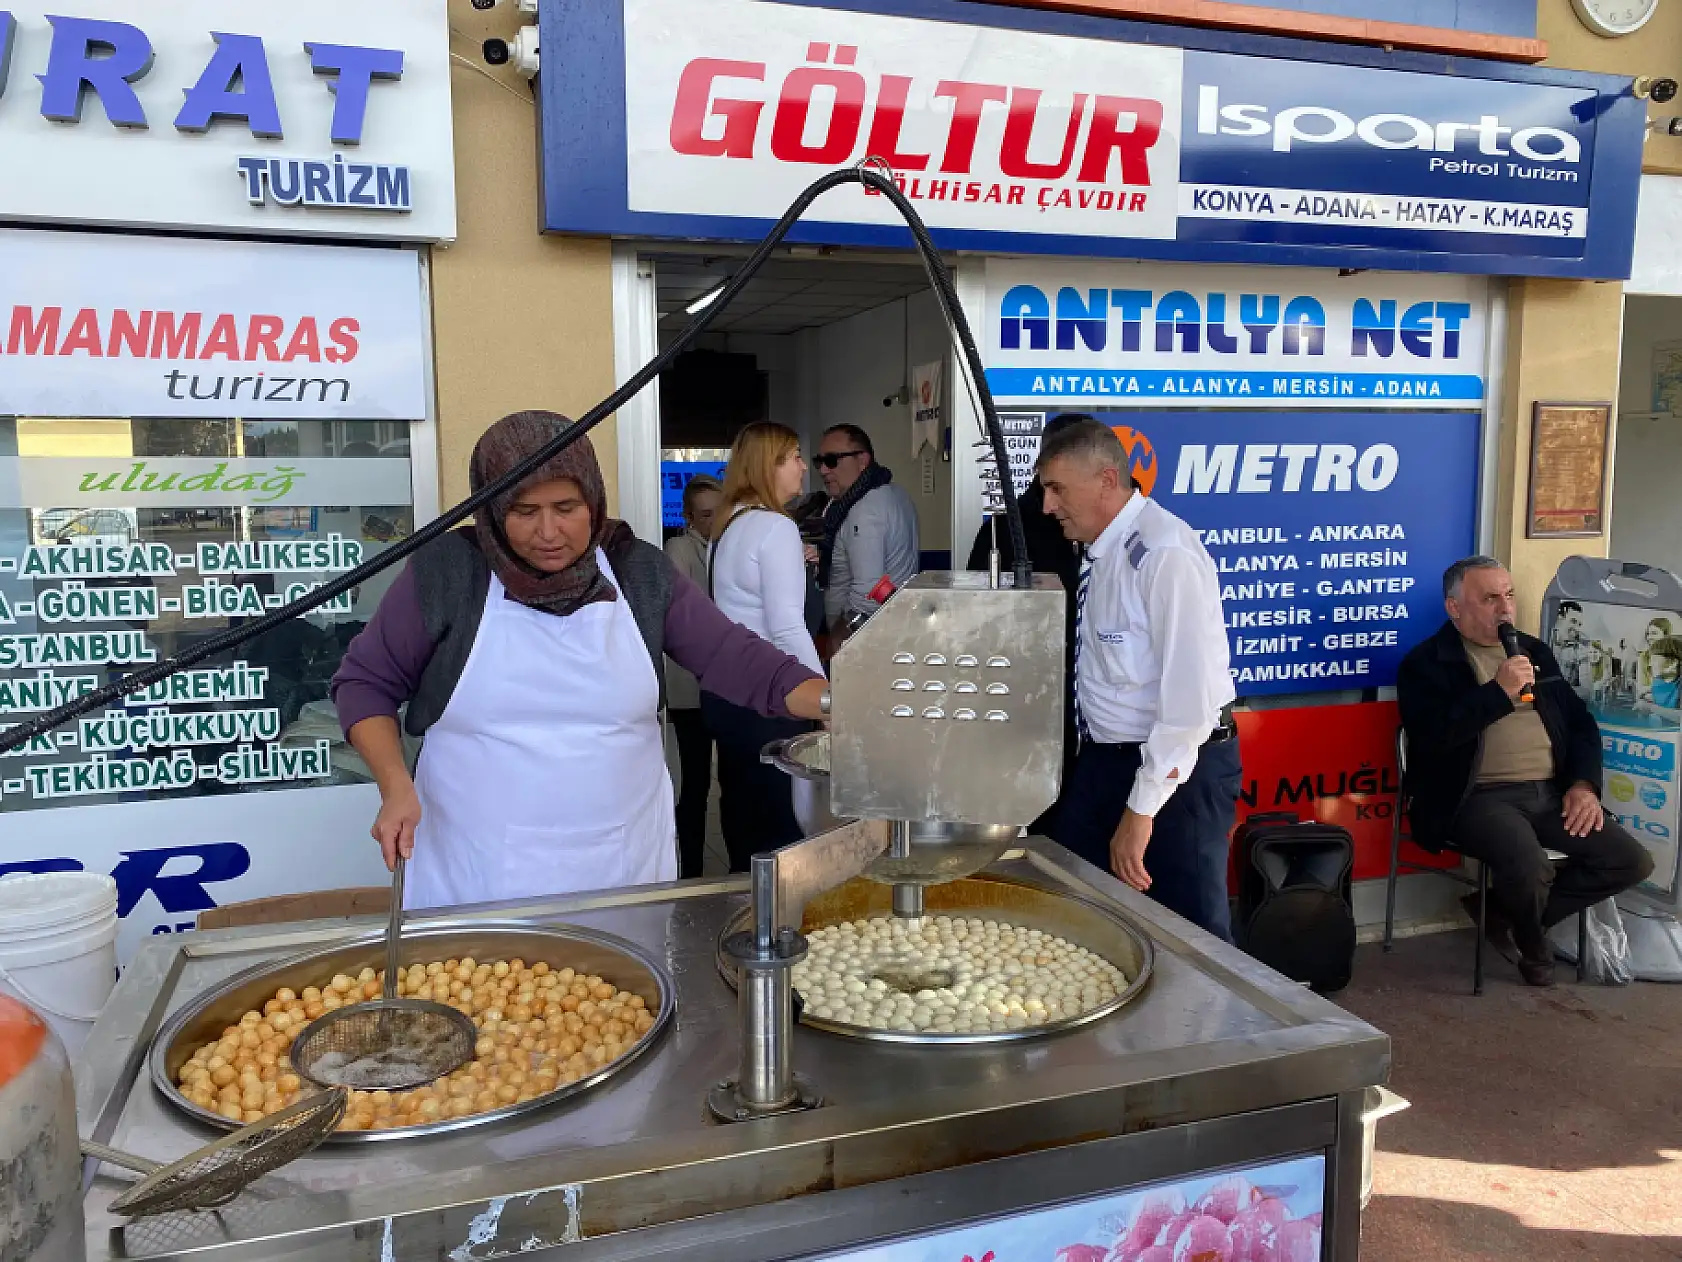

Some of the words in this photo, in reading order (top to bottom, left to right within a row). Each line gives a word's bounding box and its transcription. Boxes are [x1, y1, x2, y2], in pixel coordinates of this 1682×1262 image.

[0, 11, 406, 145] RAT
[669, 41, 1163, 187] GÖLTUR
[1198, 85, 1580, 163] Isparta
[238, 153, 411, 210] TURİZM
[1429, 157, 1498, 176] Petrol
[1037, 187, 1147, 213] ÇAVDIR
[1193, 189, 1274, 213] KONYA
[1294, 195, 1376, 220] ADANA
[1397, 202, 1465, 225] HATAY
[1483, 207, 1573, 236] K.MARAŞ
[0, 304, 361, 365] MANMARAŞ
[1001, 284, 1326, 356] ANTALYA
[1351, 297, 1471, 359] NET
[164, 369, 351, 402] turizm
[1031, 376, 1140, 393] ANTALYA
[1162, 376, 1251, 394] ALANYA
[1272, 376, 1353, 395] MERSİN
[1373, 379, 1441, 396] ADANA
[79, 461, 306, 502] uludağ
[1172, 443, 1399, 494] METRO
[1308, 524, 1405, 541] ANKARA
[23, 537, 171, 575] AKHİSAR
[201, 534, 362, 571] BALIKESİR
[1216, 555, 1299, 572] LANYA
[1320, 548, 1407, 569] MERSİN
[43, 584, 156, 619] GÖNEN
[187, 580, 262, 613] BİGA
[1316, 577, 1415, 596] G.ANTEP
[1225, 606, 1312, 627] IKESİR
[1333, 603, 1408, 623] BURSA
[1236, 634, 1303, 656] İZMİT
[1323, 630, 1398, 650] GEBZE
[129, 663, 266, 702] DREMİT
[84, 710, 277, 748] KÜÇÜKKUYU
[31, 752, 192, 794] TEKİRDAĞ
[223, 740, 329, 779] SİLİVRİ
